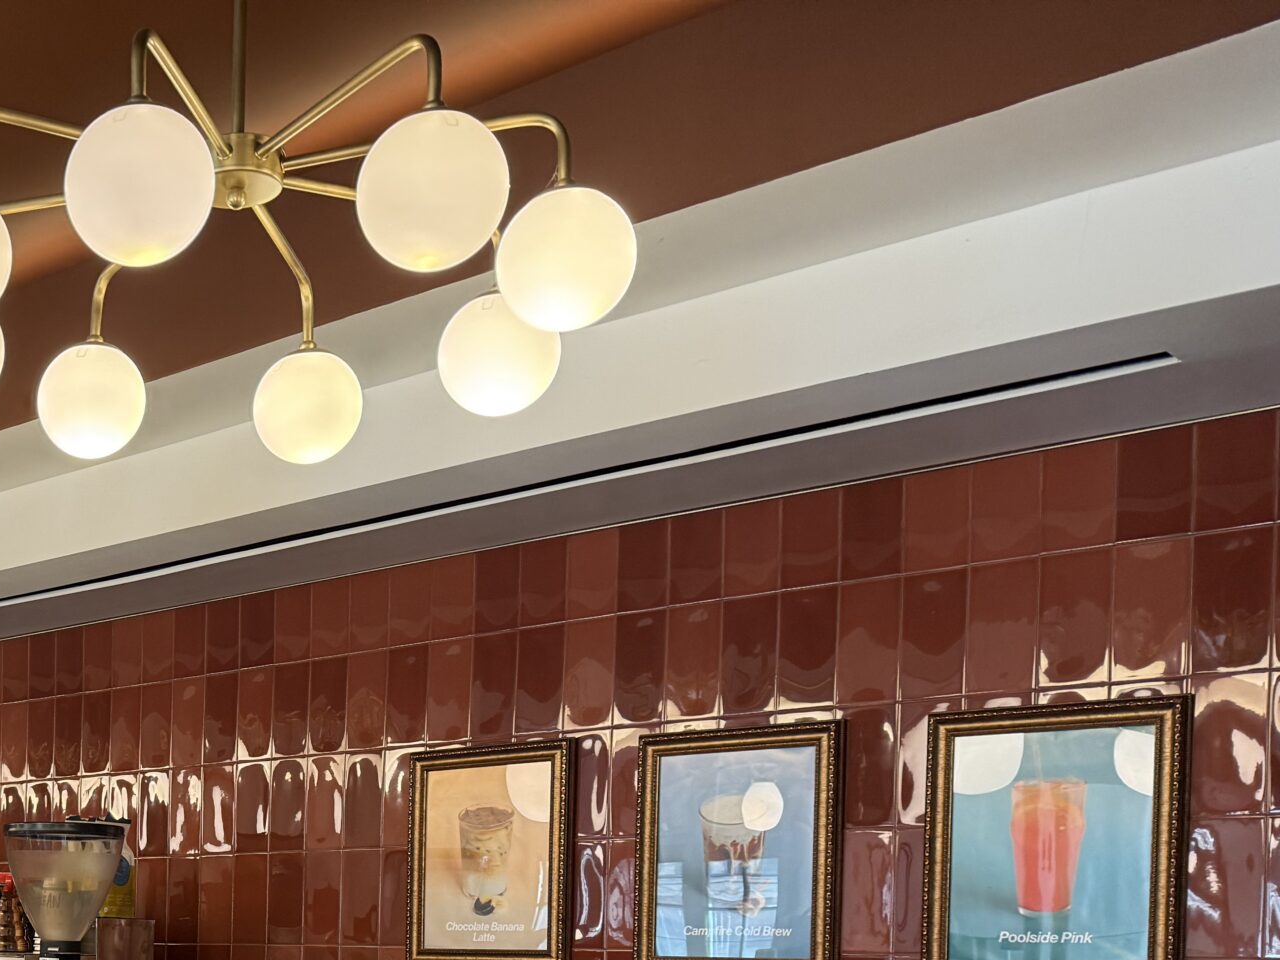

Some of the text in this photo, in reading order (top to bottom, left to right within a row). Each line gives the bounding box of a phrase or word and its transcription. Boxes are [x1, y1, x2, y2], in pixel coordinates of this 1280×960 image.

[445, 921, 525, 932] Chocolate Banana
[734, 925, 761, 937] Cold
[762, 926, 793, 937] Brew
[472, 932, 496, 942] Latte
[998, 930, 1094, 944] Poolside Pink
